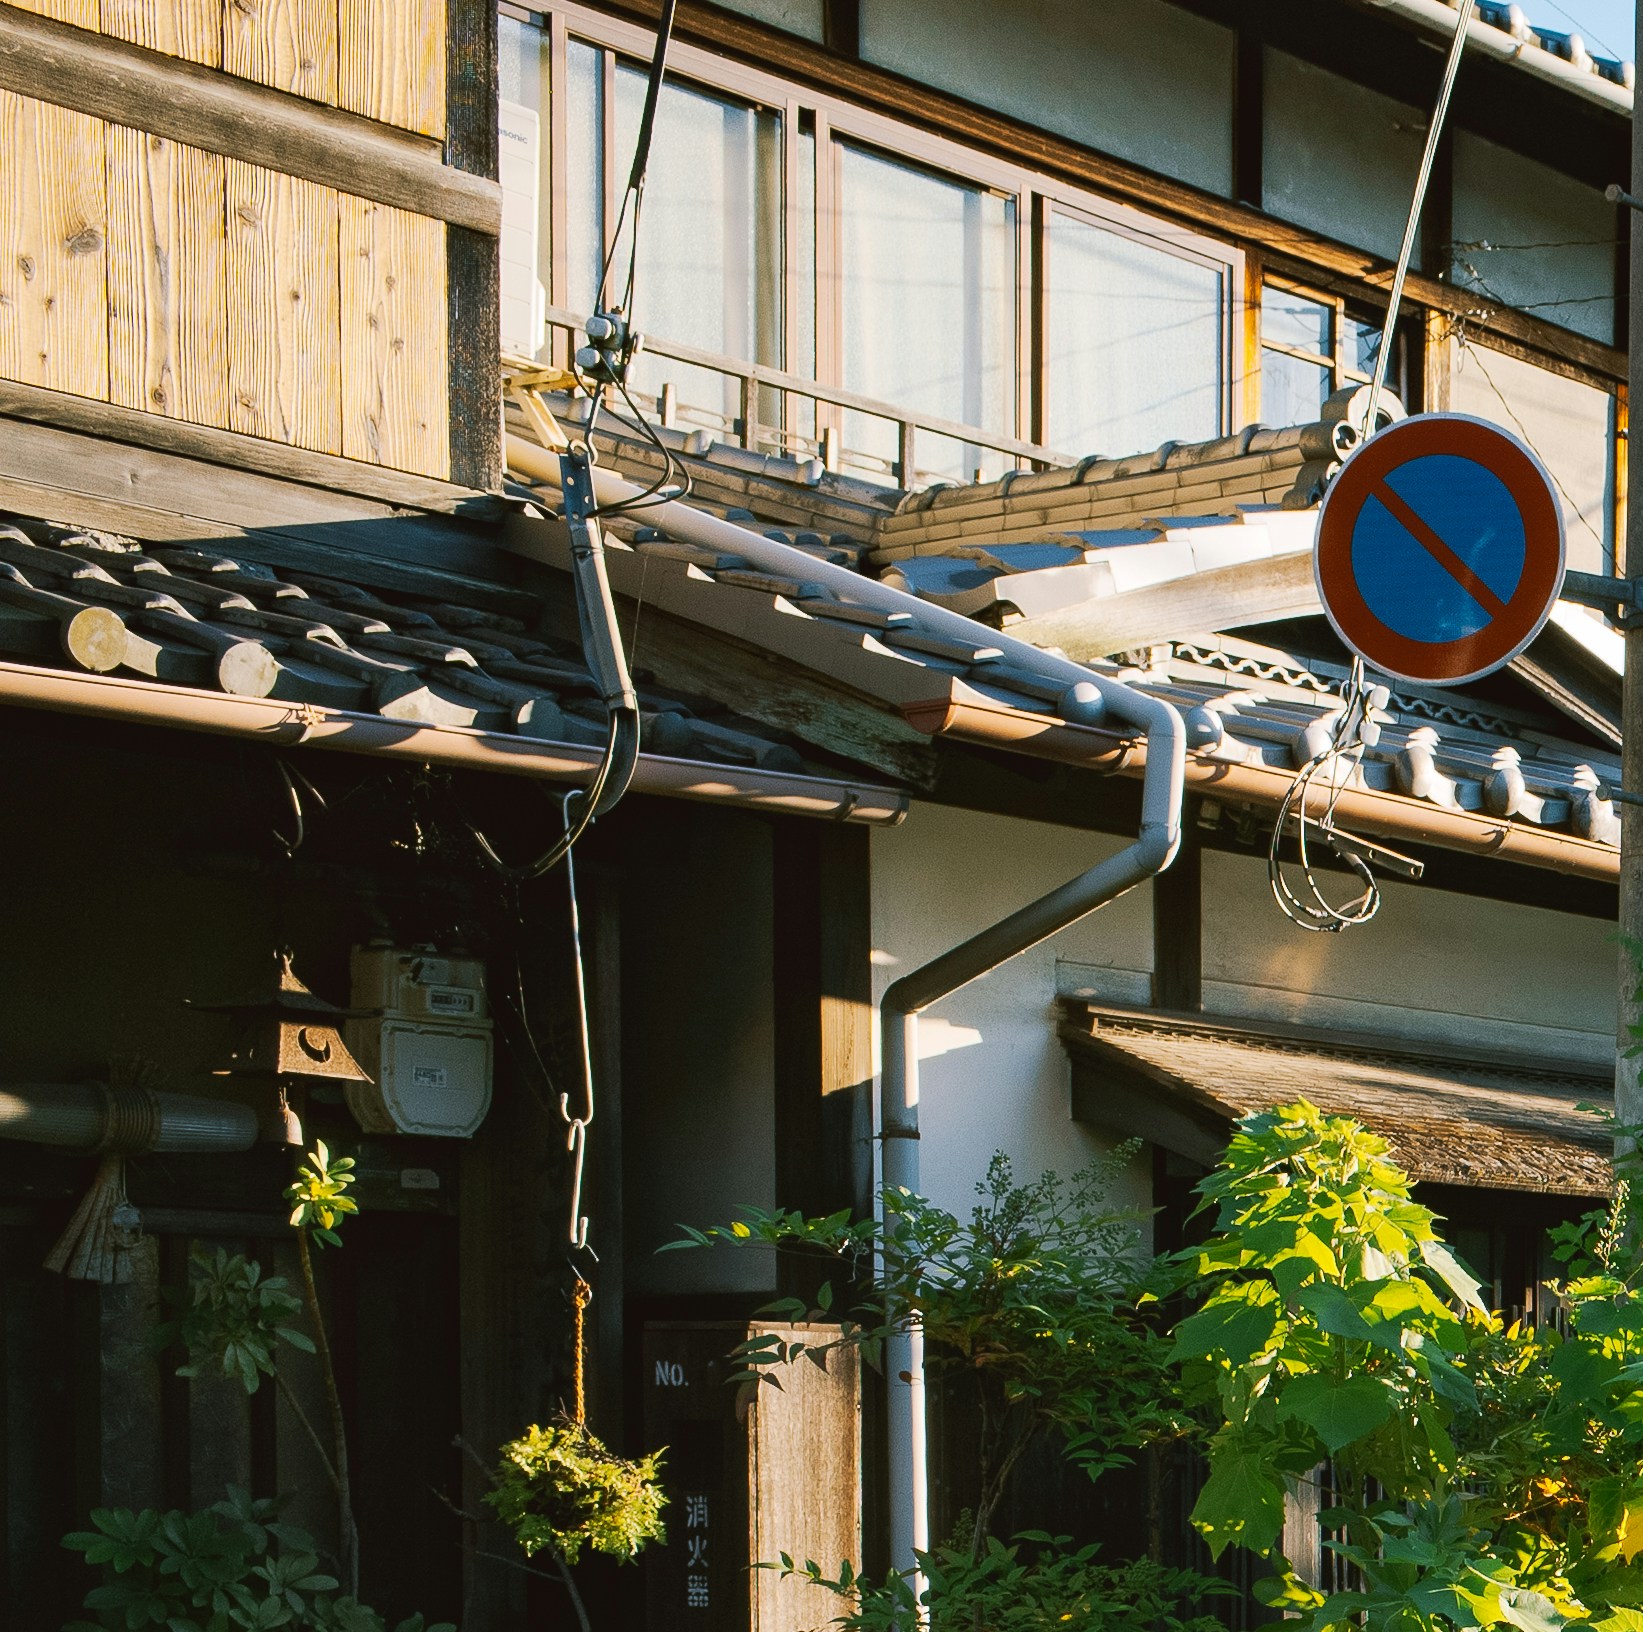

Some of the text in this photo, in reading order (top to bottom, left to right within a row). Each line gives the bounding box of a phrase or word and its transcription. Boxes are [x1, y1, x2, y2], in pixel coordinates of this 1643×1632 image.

[655, 1360, 689, 1387] NO.
[686, 1496, 709, 1607] 消火器
